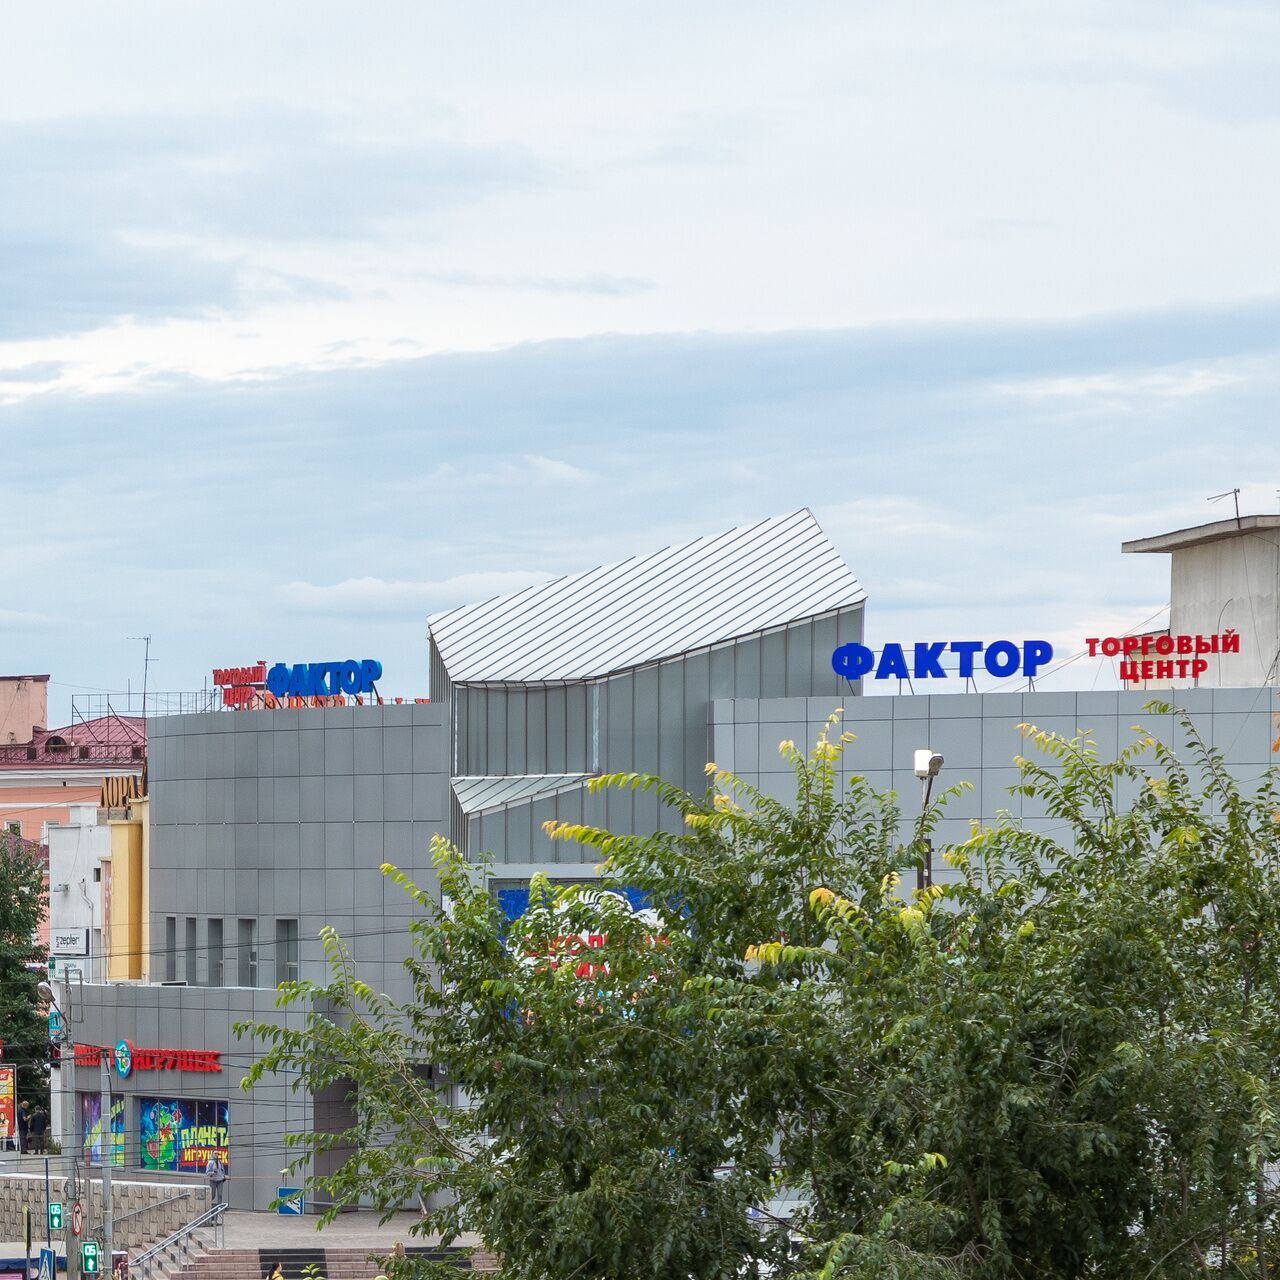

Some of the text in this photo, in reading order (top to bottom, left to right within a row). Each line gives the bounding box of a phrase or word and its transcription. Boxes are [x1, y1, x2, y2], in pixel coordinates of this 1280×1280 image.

[1086, 629, 1241, 657] ТОРГОВЫЙ
[831, 639, 1054, 680] ФАКТОР
[1119, 658, 1208, 683] ЦЕНТР
[213, 660, 267, 686] ТОРГОВЫЙ
[267, 659, 383, 698] ФАКТОР
[133, 1048, 223, 1072] ИГРУШЕК
[50, 1205, 61, 1215] 05
[84, 1245, 96, 1256] 05
